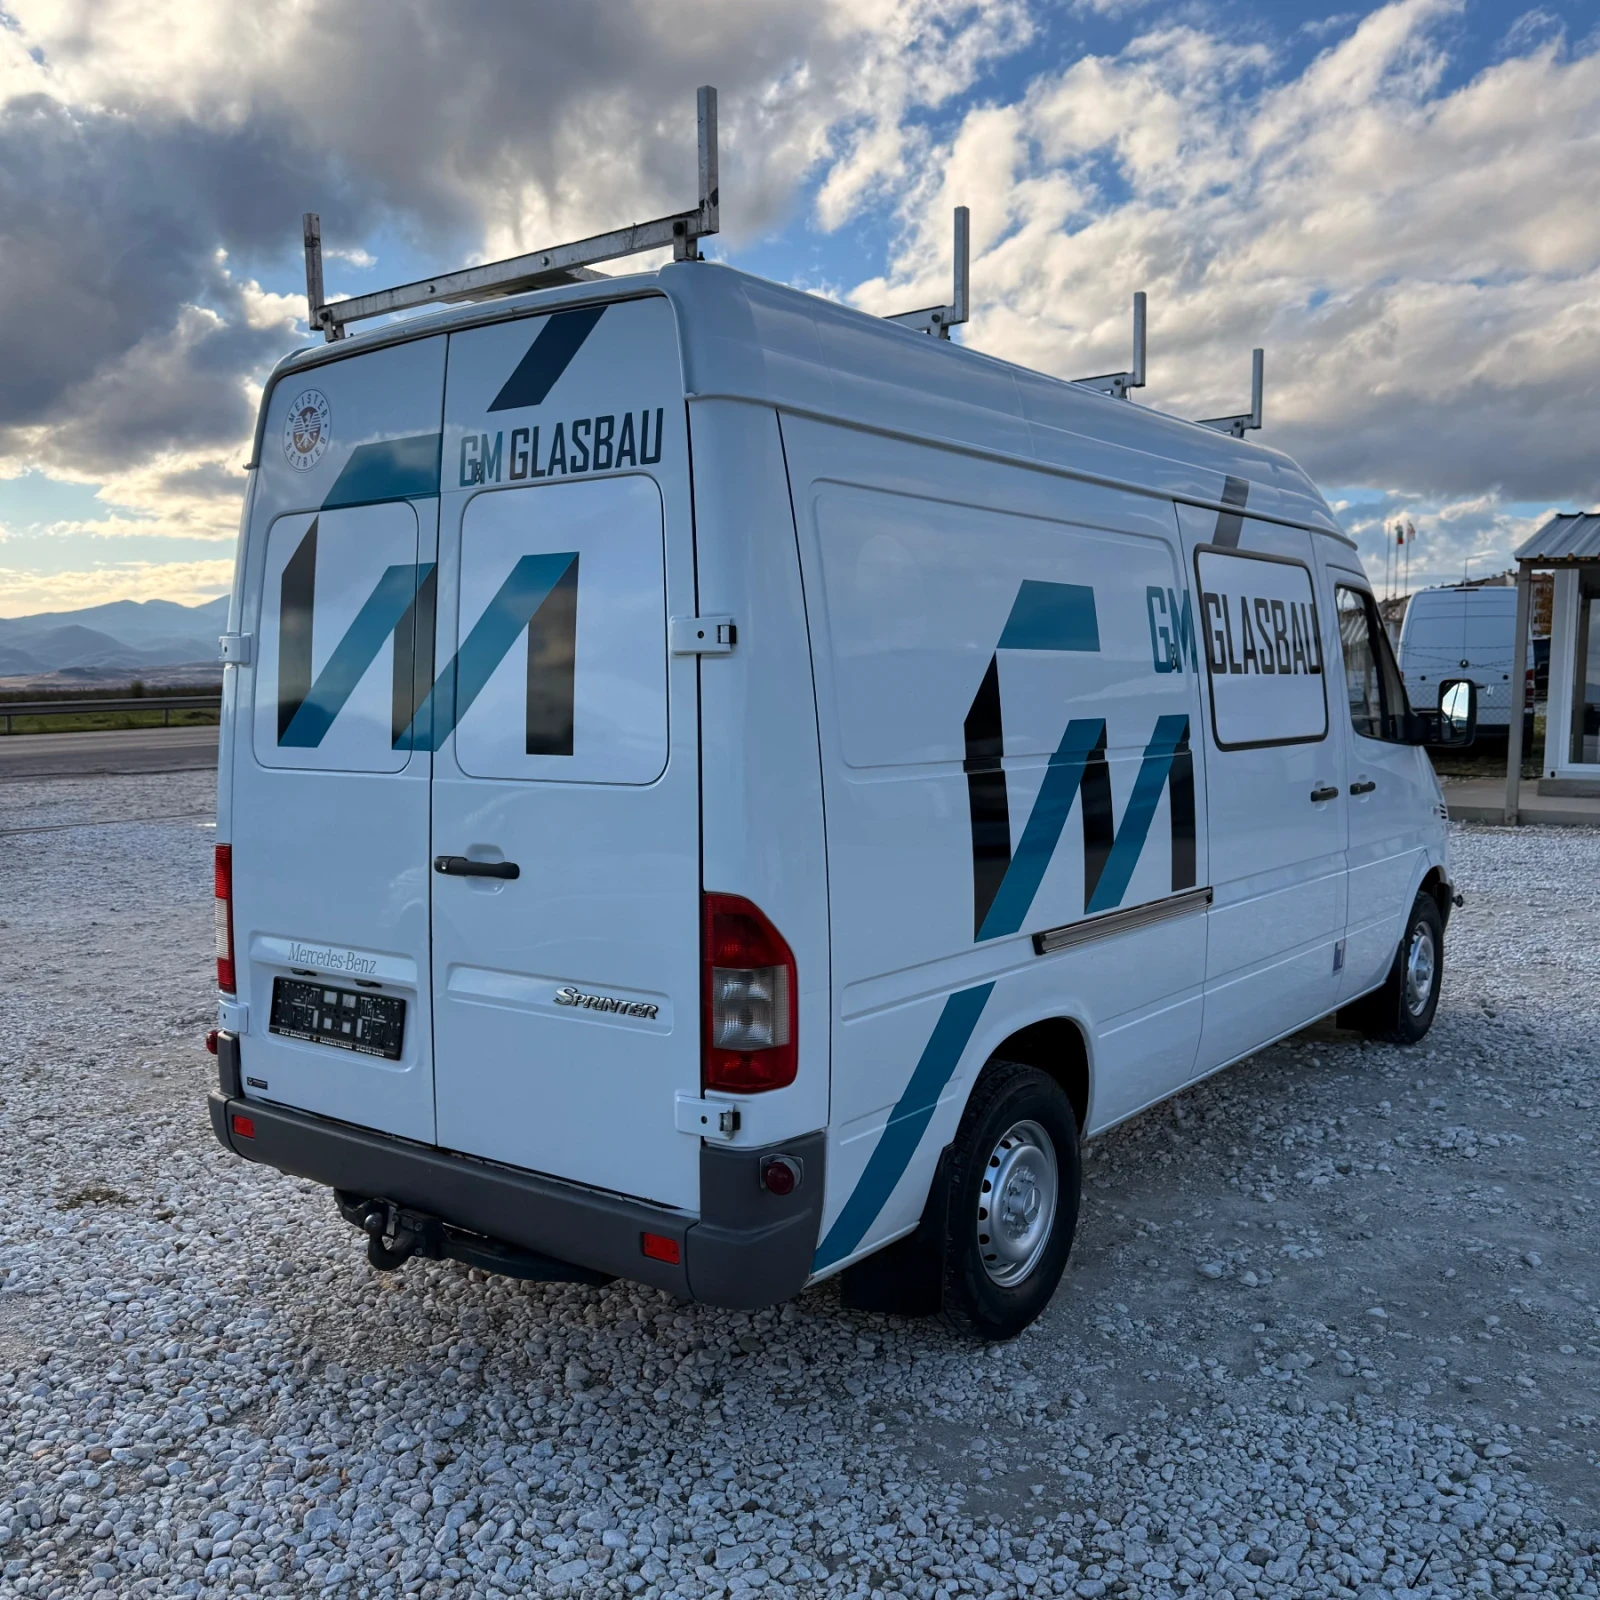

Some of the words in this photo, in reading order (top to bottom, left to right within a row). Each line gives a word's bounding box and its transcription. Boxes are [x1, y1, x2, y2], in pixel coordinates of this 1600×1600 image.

[288, 393, 328, 424] MEISTER
[509, 407, 664, 481] GLASBAU
[1203, 591, 1322, 675] GLASBAU
[287, 942, 377, 975] Mercedes-Benz
[553, 985, 659, 1020] SPRINTER
